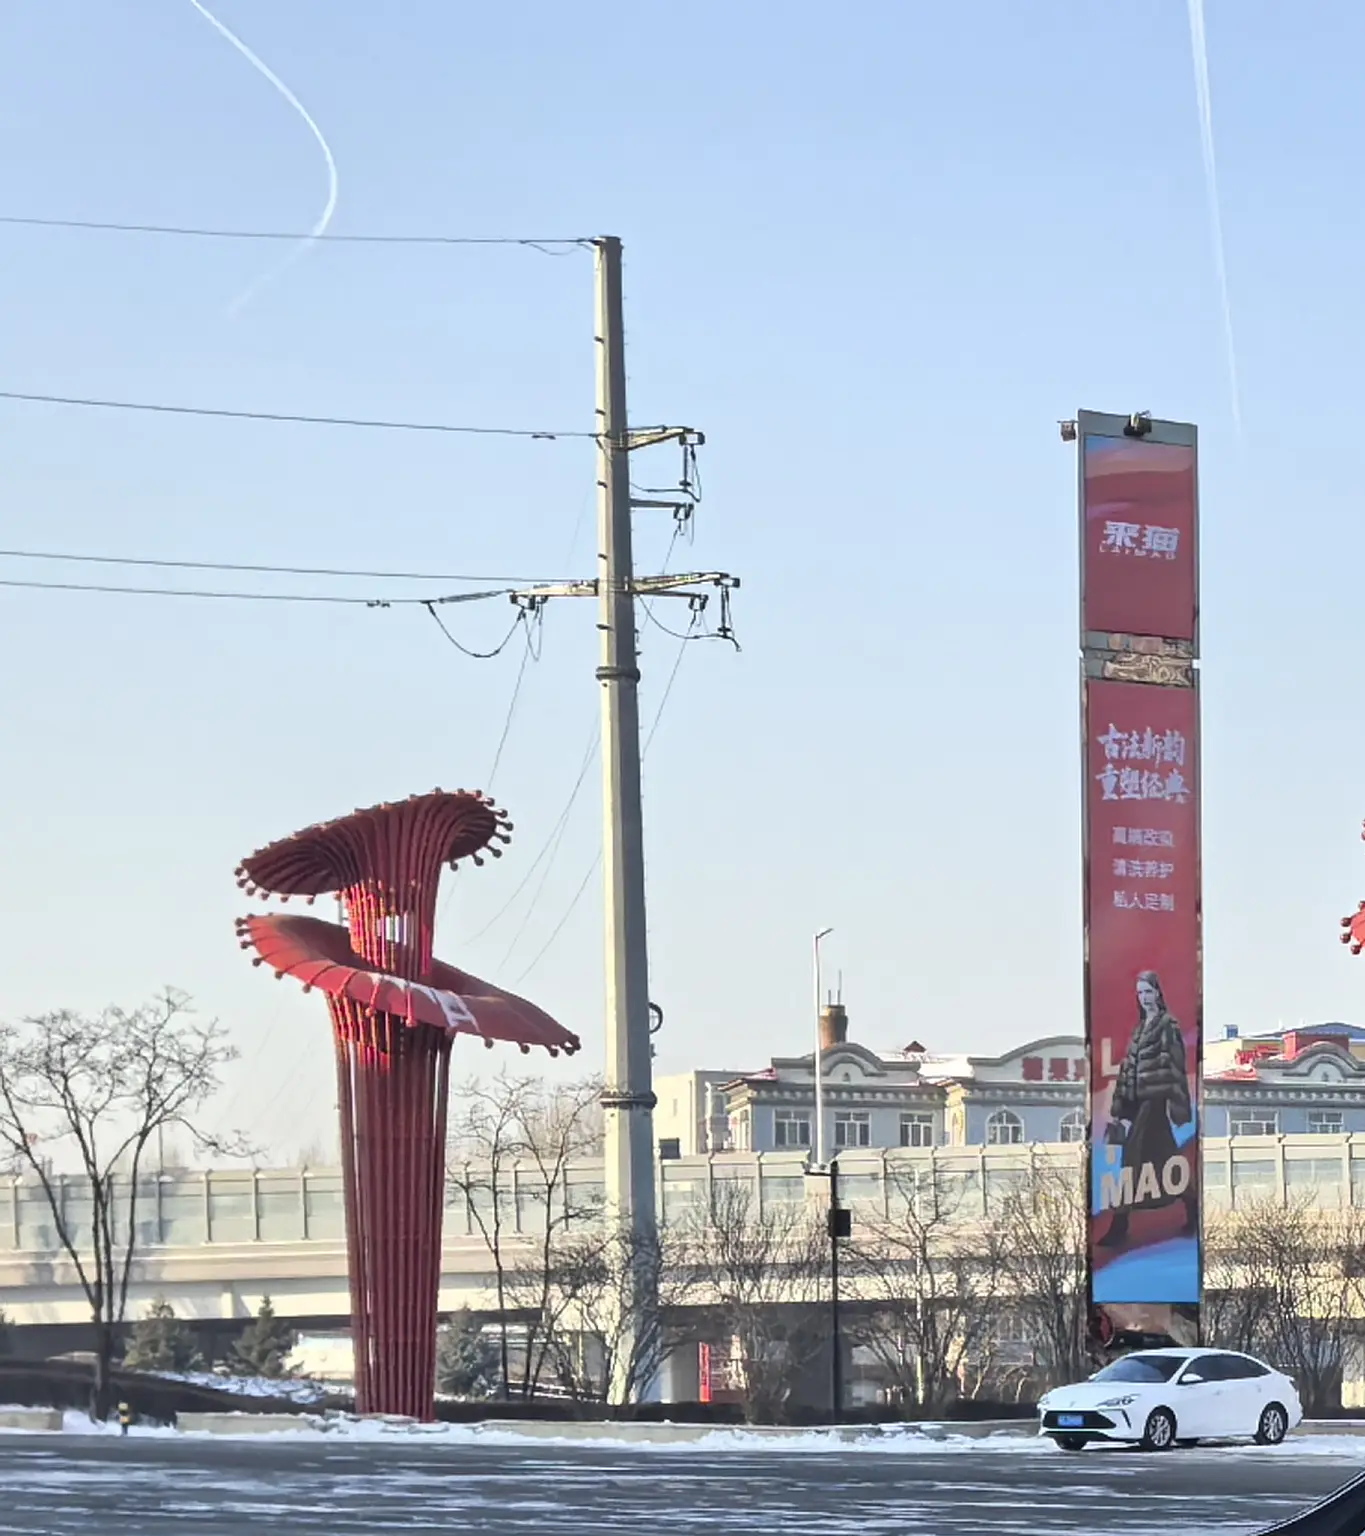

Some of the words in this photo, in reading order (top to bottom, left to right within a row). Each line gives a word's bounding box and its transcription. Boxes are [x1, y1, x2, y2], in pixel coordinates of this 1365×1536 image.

[1095, 763, 1191, 805] 重塑经典
[1113, 889, 1175, 912] 私人定制
[1100, 1155, 1190, 1210] MAO
